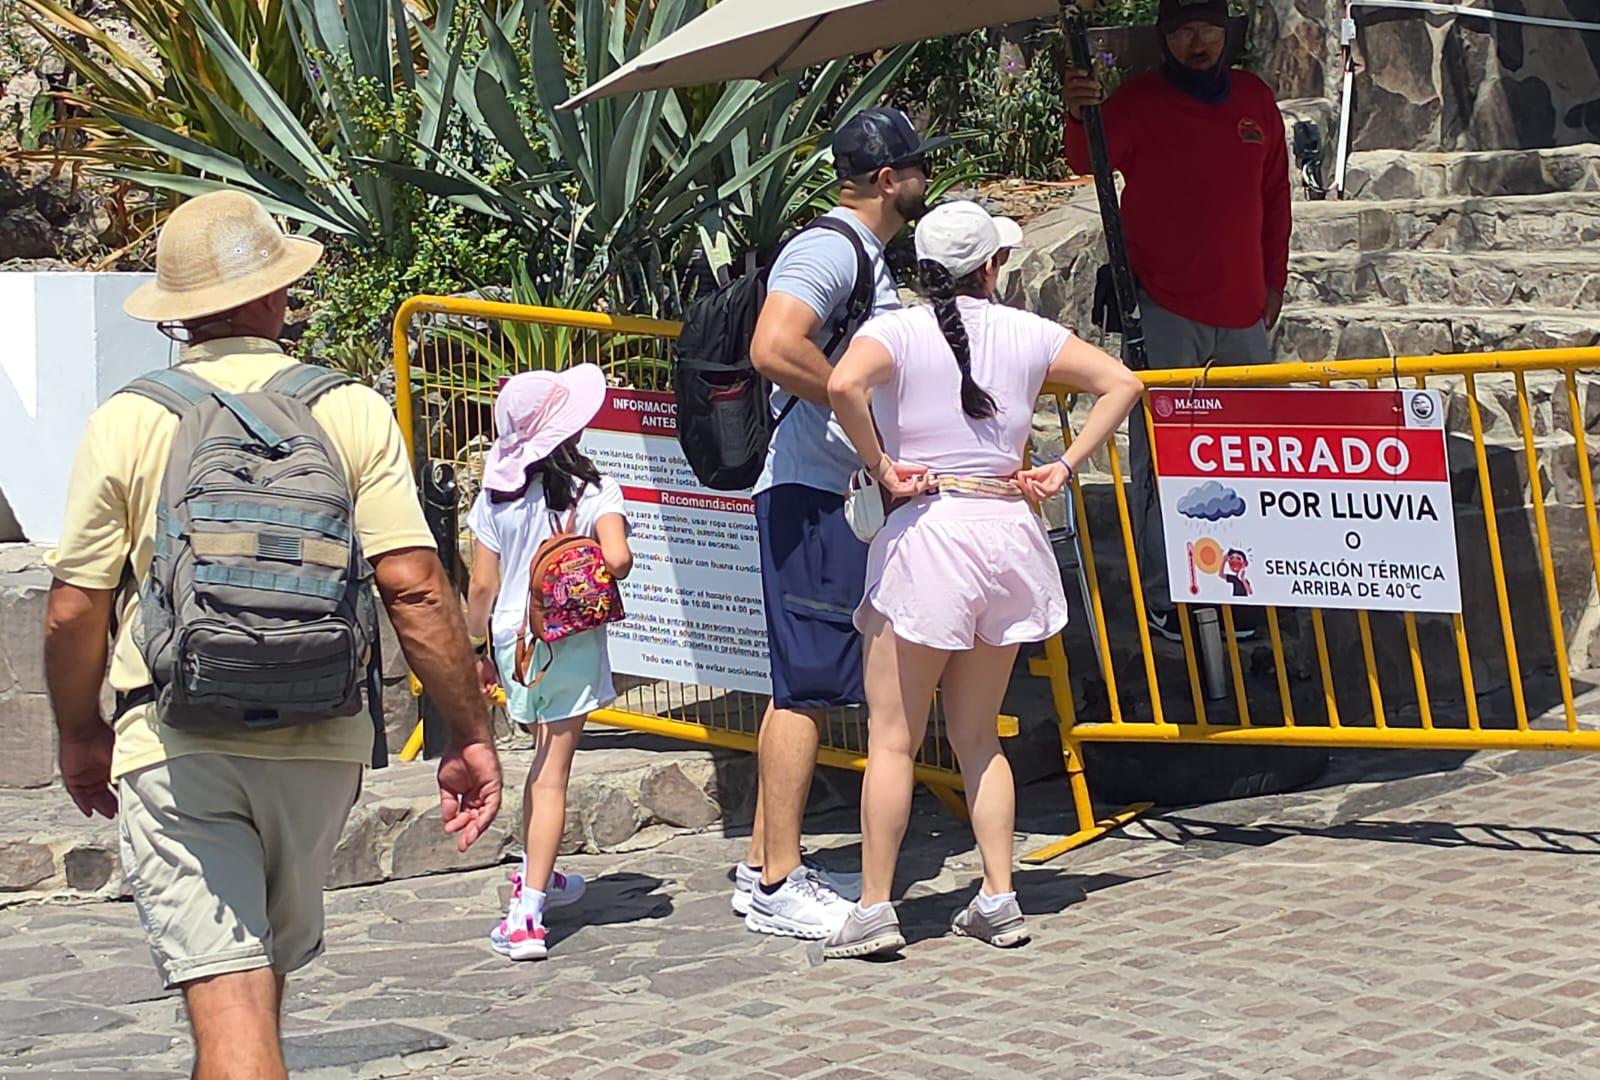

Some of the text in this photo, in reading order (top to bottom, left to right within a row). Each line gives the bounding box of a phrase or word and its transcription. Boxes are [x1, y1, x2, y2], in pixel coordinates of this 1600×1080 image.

[1174, 398, 1223, 410] MARINA
[642, 415, 677, 429] ANTES
[1189, 434, 1410, 476] CERRADO
[1260, 491, 1439, 521] POR LLUVIA
[1345, 531, 1361, 550] O
[1265, 559, 1445, 580] SENSACIÓN TÉRMICA
[1291, 581, 1352, 597] ARRIBA
[1358, 583, 1380, 597] DE
